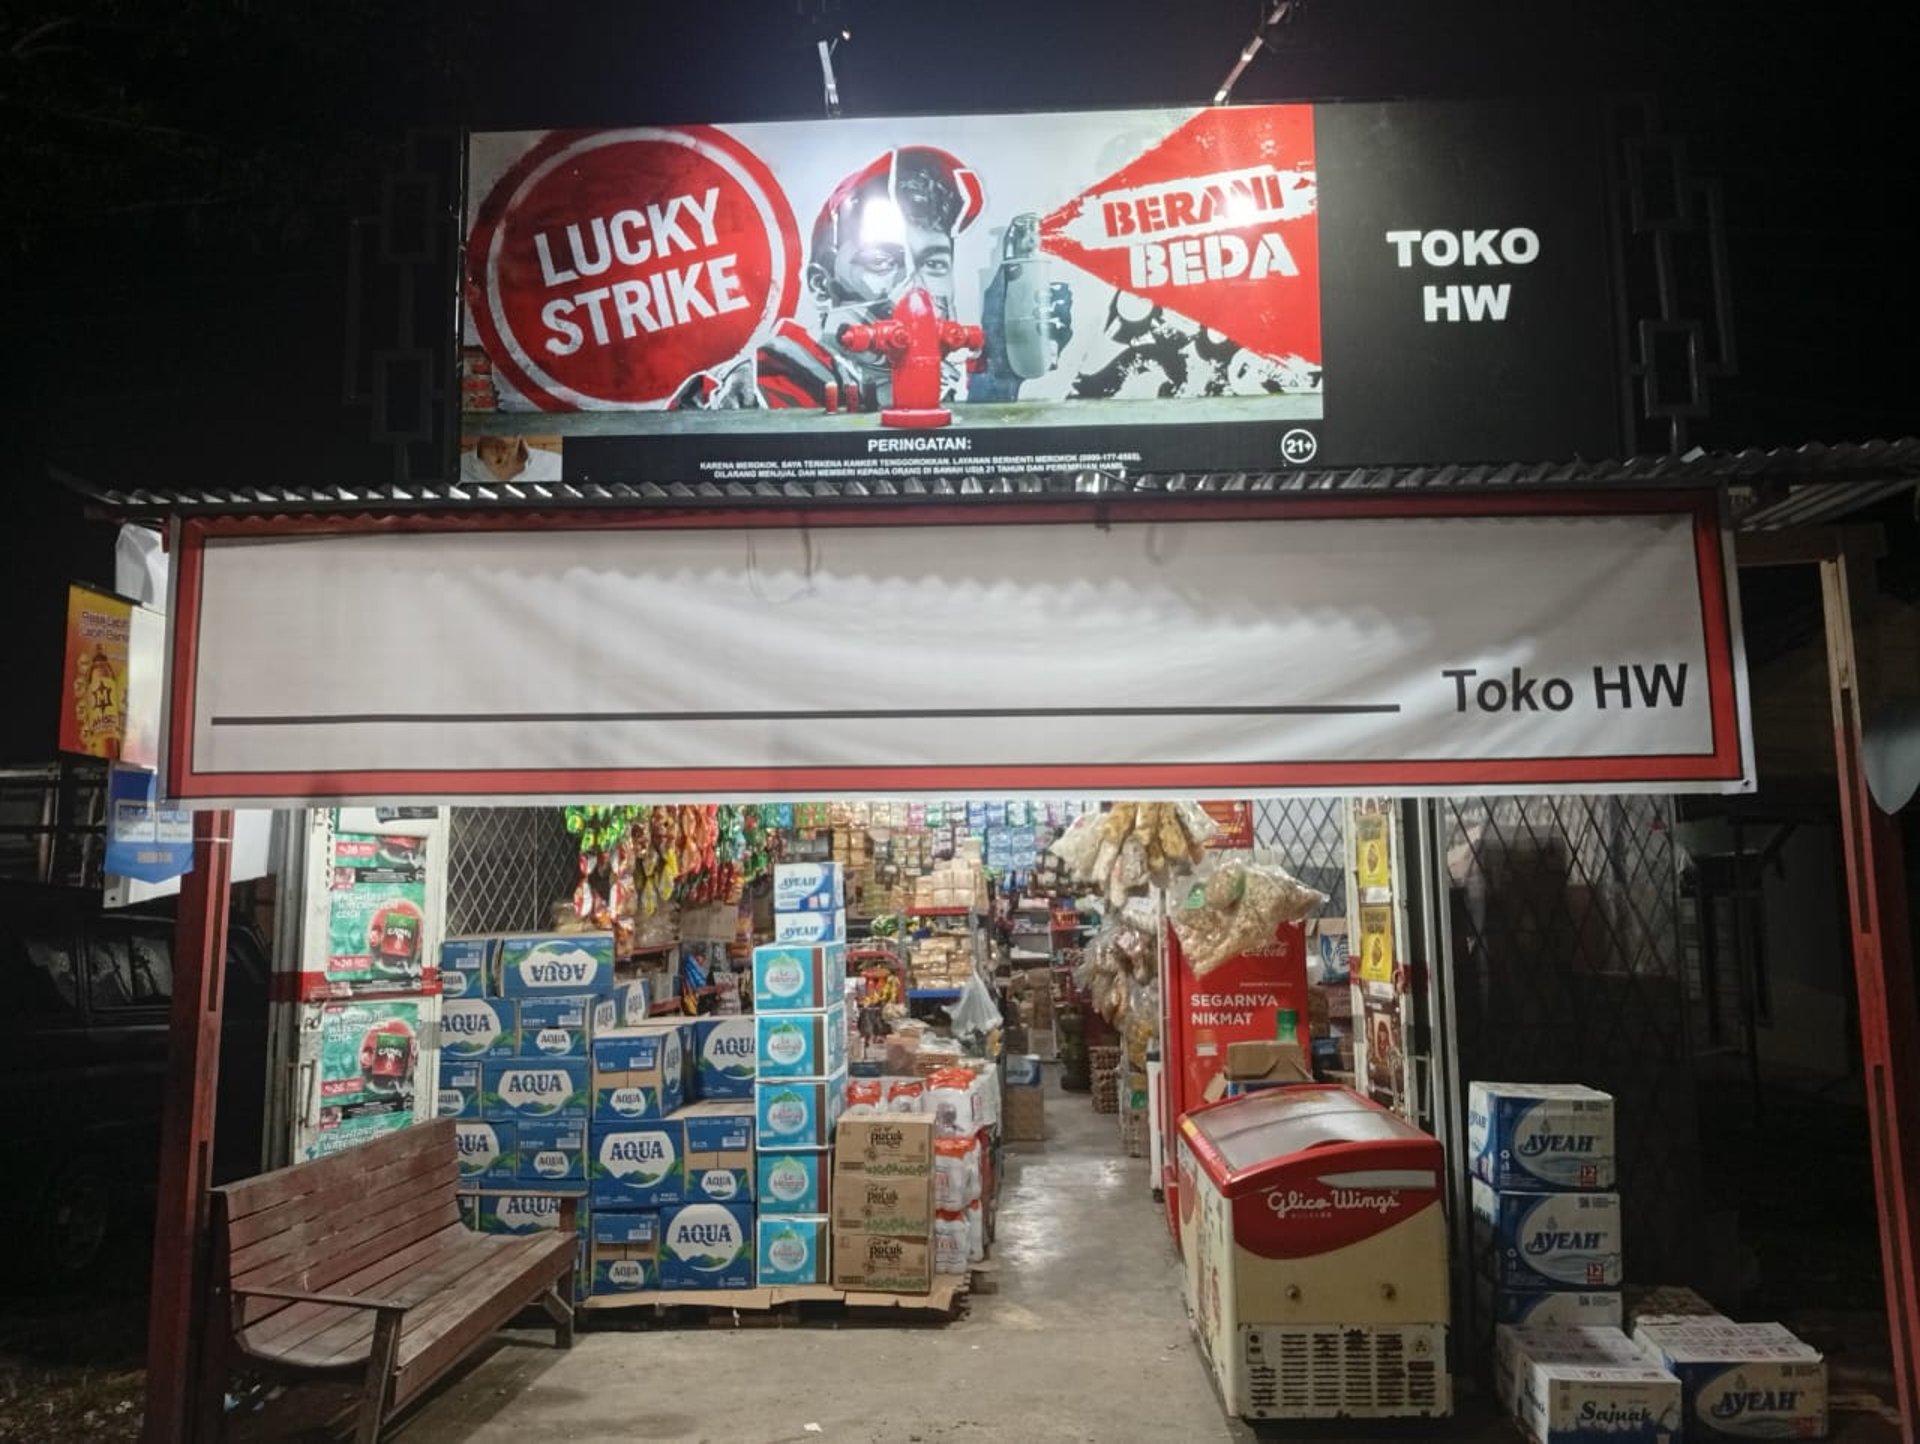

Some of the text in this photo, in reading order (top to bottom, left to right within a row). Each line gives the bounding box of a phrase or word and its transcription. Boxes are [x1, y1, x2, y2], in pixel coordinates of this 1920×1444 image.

[1104, 174, 1285, 238] BERANI
[535, 188, 720, 288] LUCKY
[1386, 228, 1540, 268] TOKO
[1128, 233, 1298, 289] BEDA
[541, 254, 750, 357] STRIKE
[1424, 284, 1511, 322] HW
[867, 437, 972, 452] PERINGATAN:
[1286, 438, 1313, 453] 21+
[700, 461, 734, 470] KARENA
[781, 460, 801, 469] SAYA
[804, 459, 842, 468] TERKENA
[844, 459, 877, 468] KANKER
[952, 456, 990, 465] LAYANAN
[993, 455, 1034, 464] BERHENTI
[1035, 454, 1077, 463] MEROKOK
[714, 470, 756, 478] DILARANG
[758, 469, 796, 478] MENJUAL
[798, 469, 816, 477] DAN
[818, 468, 855, 477] MEMBERI
[857, 468, 890, 476] KEPADA
[891, 467, 921, 475] ORANG
[923, 467, 932, 475] DI
[933, 466, 963, 475] BAWAH
[965, 465, 984, 474] USIA
[986, 465, 995, 474] 21
[997, 465, 1024, 473] TAHUN
[1026, 464, 1044, 472] DAN
[1442, 663, 1688, 712] Toko HW
[530, 961, 587, 981] AQUA
[1191, 994, 1278, 1007] SEGARNYA
[440, 1013, 491, 1035] AQUA
[1191, 1012, 1253, 1025] NIKMAT
[541, 1033, 567, 1045] AQUA
[508, 1074, 563, 1095] AQUA
[616, 1094, 641, 1105] AQUA
[609, 1140, 664, 1163] AQUA
[1518, 1135, 1595, 1156] AYEAH
[538, 1156, 564, 1167] AQUA
[705, 1176, 732, 1187] AQUA
[506, 1198, 560, 1216] AQUA
[1267, 1189, 1401, 1219] Glico Wings
[677, 1224, 732, 1246] AQUA
[1524, 1232, 1600, 1255] AYEAH
[613, 1267, 639, 1278] AQUA
[1711, 1391, 1798, 1418] AYEAH
